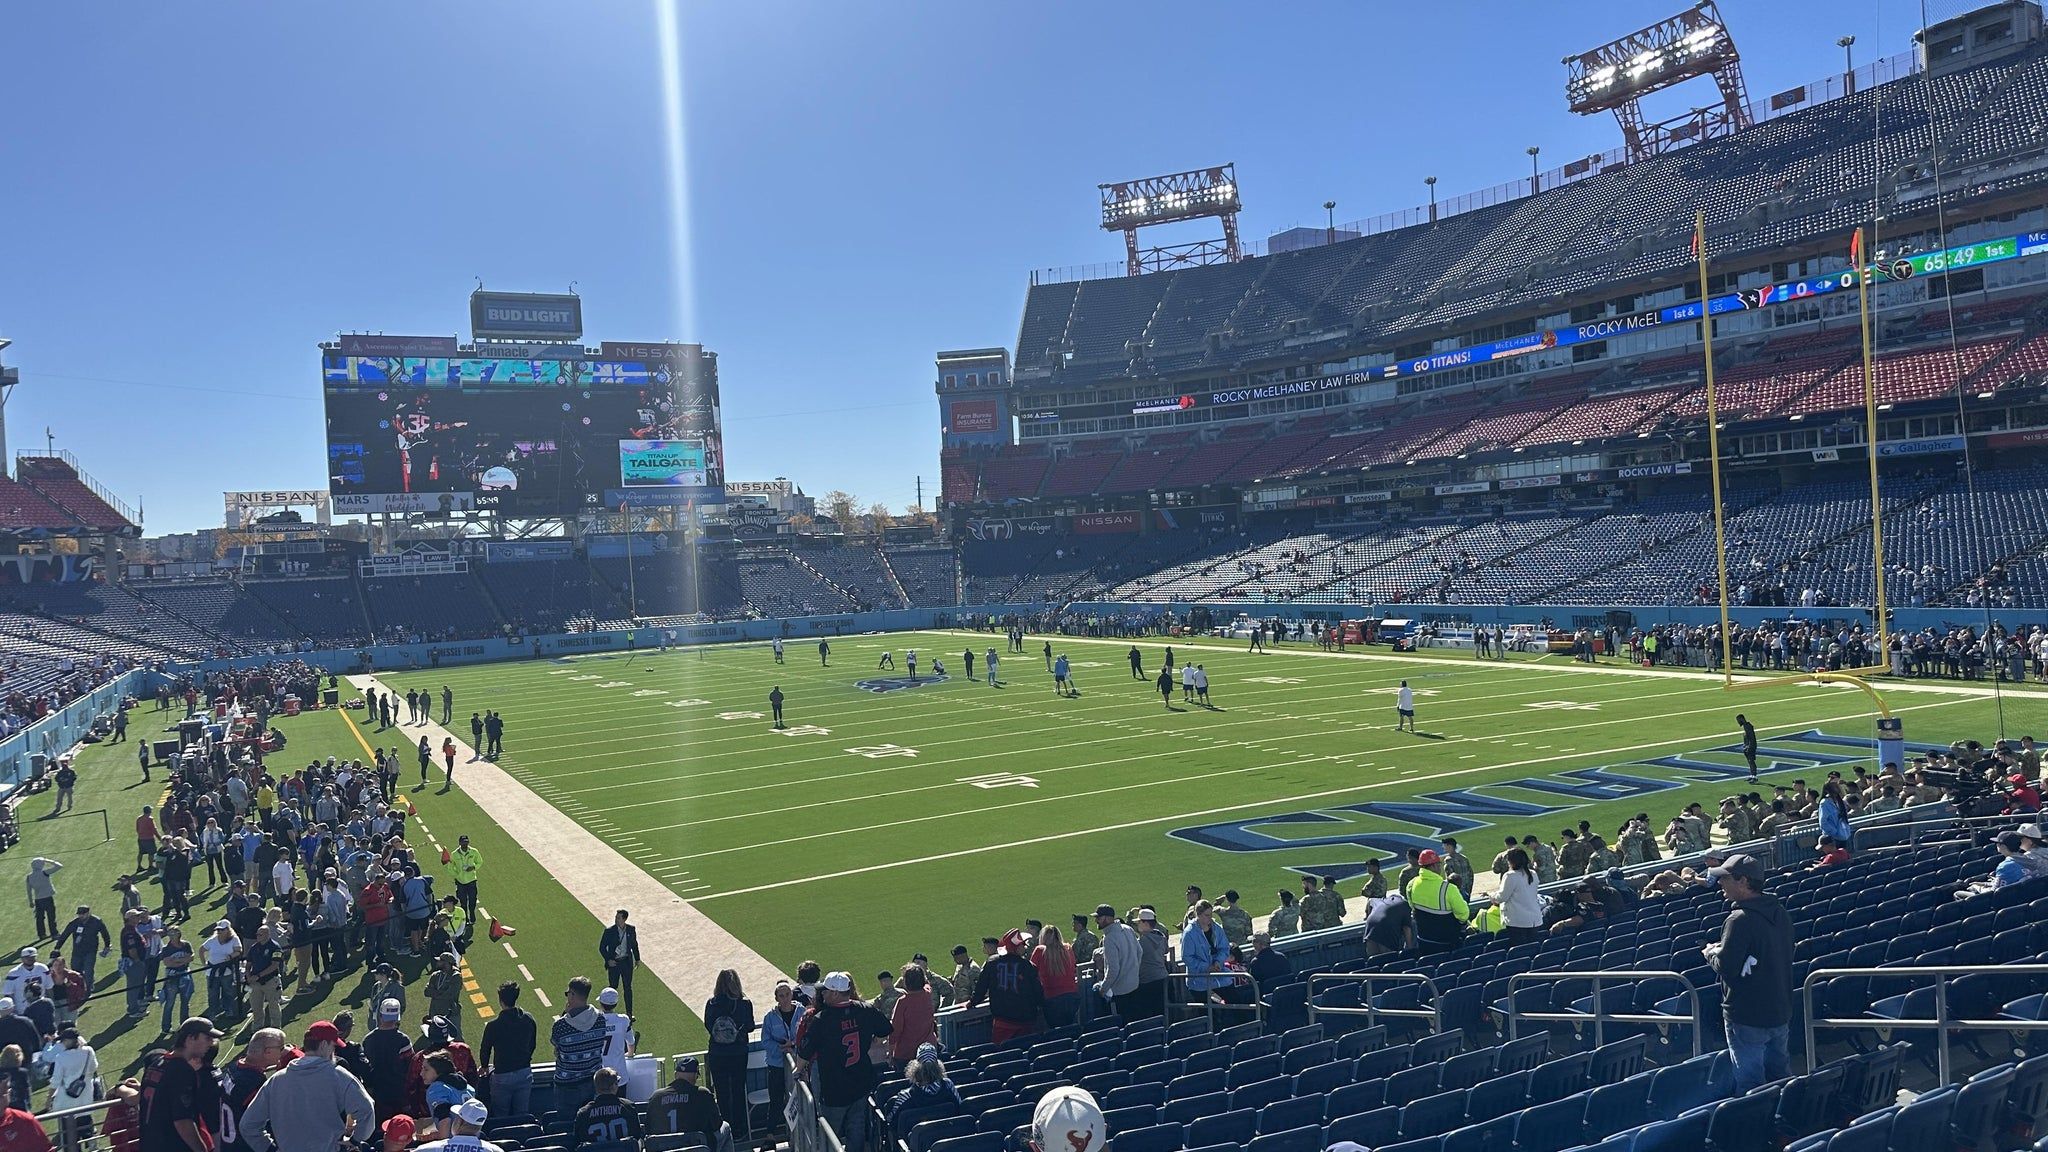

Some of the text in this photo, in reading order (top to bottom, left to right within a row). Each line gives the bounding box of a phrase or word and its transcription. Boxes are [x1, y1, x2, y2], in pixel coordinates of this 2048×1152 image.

[1985, 244, 2005, 258] 1st
[1924, 249, 1975, 272] 65:49
[1841, 274, 1852, 288] 0
[1797, 282, 1807, 296] 0
[488, 308, 569, 323] BUD LIGHT
[1673, 307, 1695, 320] 1st &
[1578, 312, 1662, 339] ROCKY McEL
[1495, 334, 1541, 350] McELHANEY
[478, 343, 529, 359] Pinnacle
[616, 347, 690, 359] NISSAN
[1413, 351, 1471, 373] GO TITANS!
[1213, 372, 1370, 404] ROCKY McELHANEY LAW FIRM
[1136, 397, 1179, 407] McELHANEY
[956, 418, 992, 426] INSURANCE
[1899, 436, 1953, 453] Gallagher
[629, 459, 697, 468] TAILGATE
[1576, 473, 1598, 482] FedEx
[1619, 465, 1672, 479] ROCKY LAW
[725, 483, 782, 491] NISSAN
[240, 492, 316, 502] NISSAN
[337, 495, 370, 505] MARS
[587, 494, 597, 503] 25
[1350, 494, 1386, 503] Tennessean
[1028, 519, 1052, 534] Kroger
[1081, 515, 1132, 527] NISSAN
[592, 636, 611, 646] TOUGH
[464, 645, 485, 656] TOUGH
[841, 1018, 859, 1031] DELL
[842, 1031, 861, 1068] 3
[661, 1093, 689, 1105] HOWARD
[589, 1104, 624, 1118] ANTHONY
[667, 1109, 678, 1133] 1
